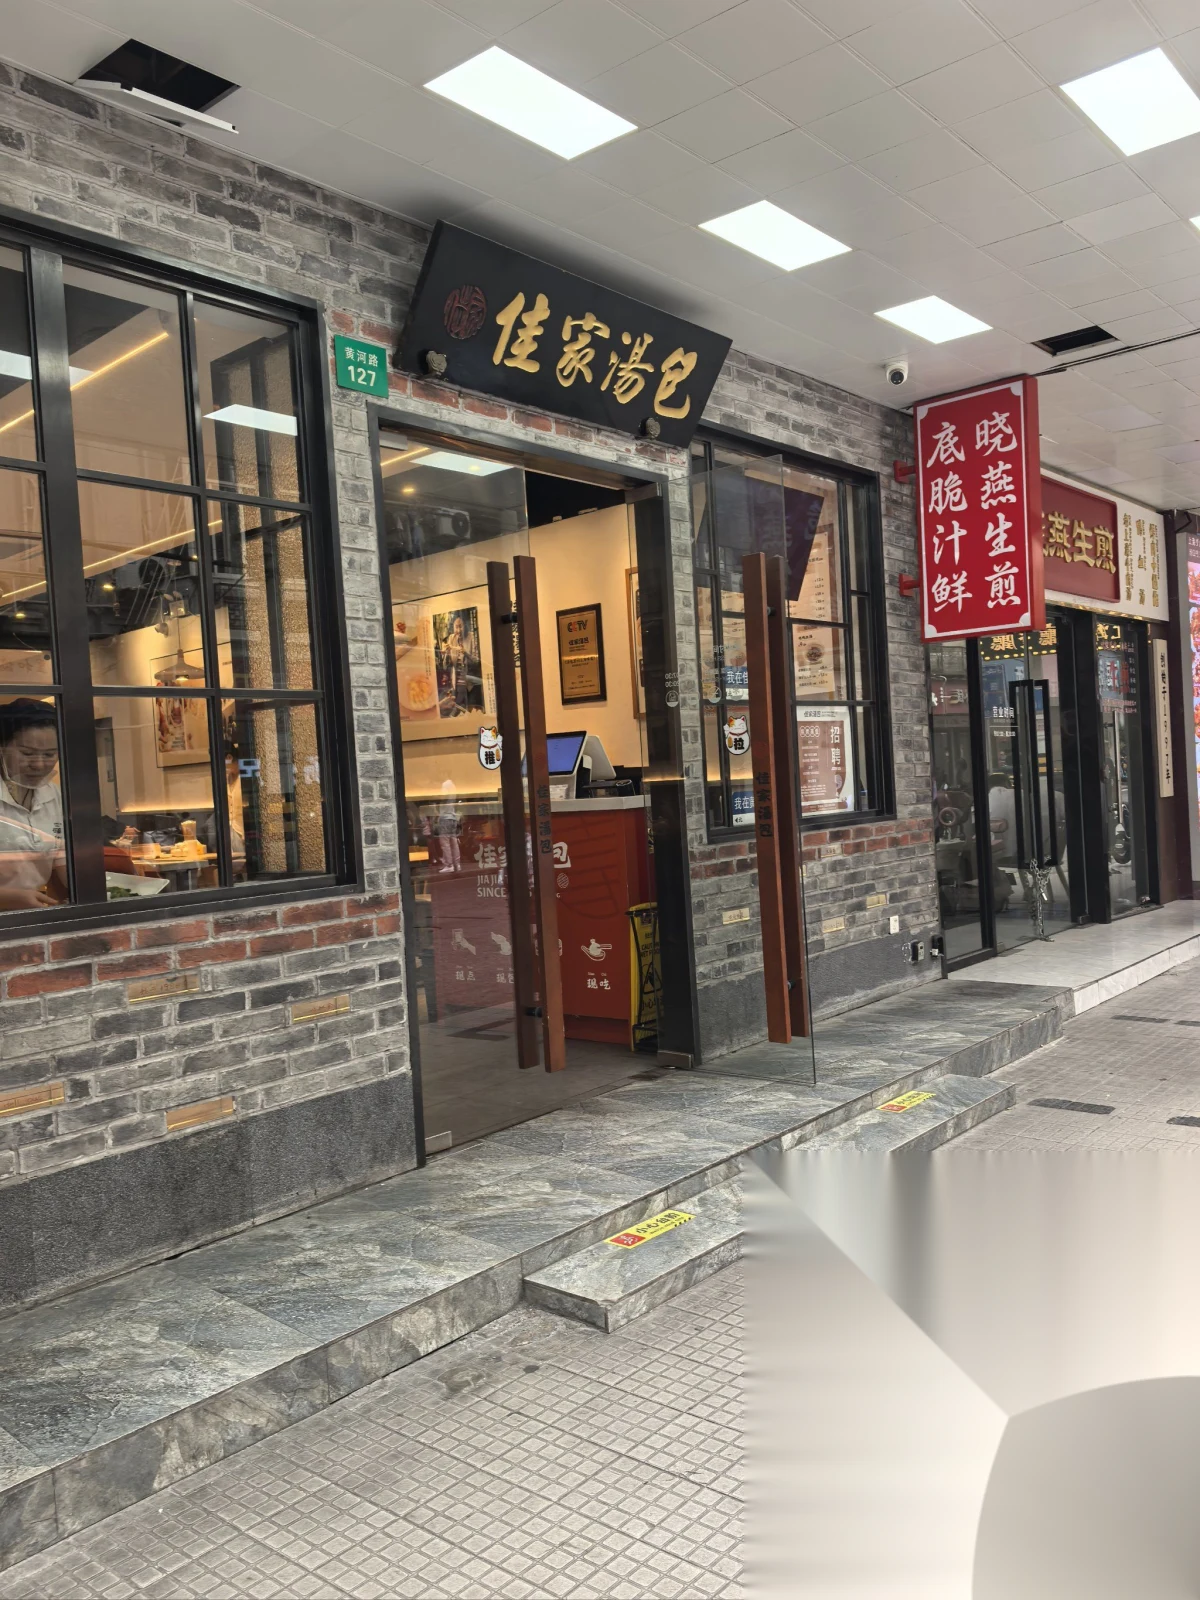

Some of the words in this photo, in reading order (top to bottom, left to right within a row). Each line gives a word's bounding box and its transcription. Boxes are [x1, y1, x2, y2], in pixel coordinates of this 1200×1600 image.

[344, 346, 378, 367] 黄河路
[347, 365, 376, 387] 127
[926, 421, 973, 613] 底脆汁鲜
[975, 411, 1022, 609] 晓燕生煎
[1042, 510, 1117, 574] 燕生煎
[567, 620, 588, 632] CCTV
[733, 738, 745, 751] 拉
[830, 726, 842, 765] 招聘
[484, 751, 496, 765] 推
[477, 887, 507, 898] SINCE
[455, 970, 475, 981] 现点
[587, 978, 611, 990] 现吃
